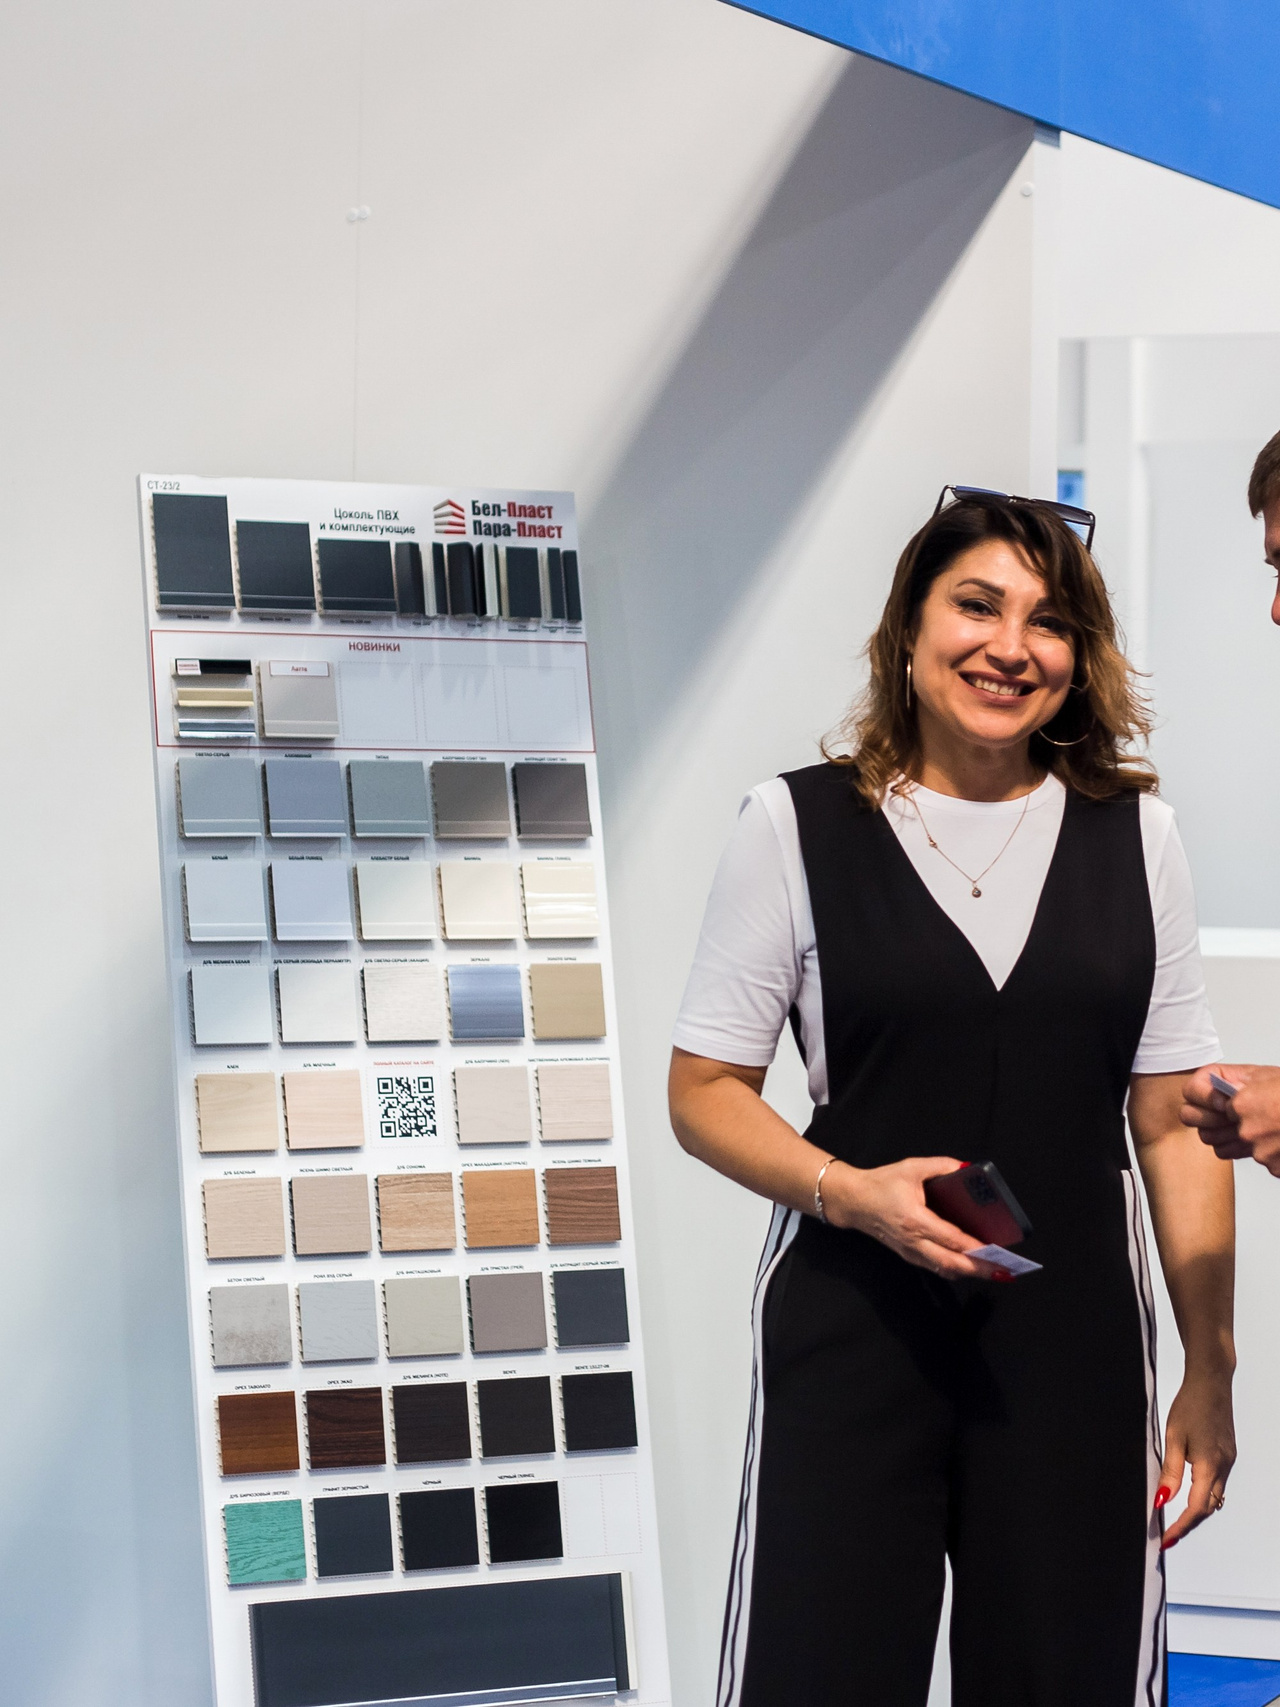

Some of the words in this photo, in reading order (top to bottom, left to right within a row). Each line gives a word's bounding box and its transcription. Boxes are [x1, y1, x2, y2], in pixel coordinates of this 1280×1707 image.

[333, 507, 374, 520] Цоколь
[376, 509, 400, 521] ПВХ
[471, 500, 554, 519] Бел-Пласт
[319, 523, 326, 531] и
[329, 523, 416, 535] комплектующие
[472, 519, 563, 539] Пара-Пласт
[348, 641, 401, 653] НОВИНКИ
